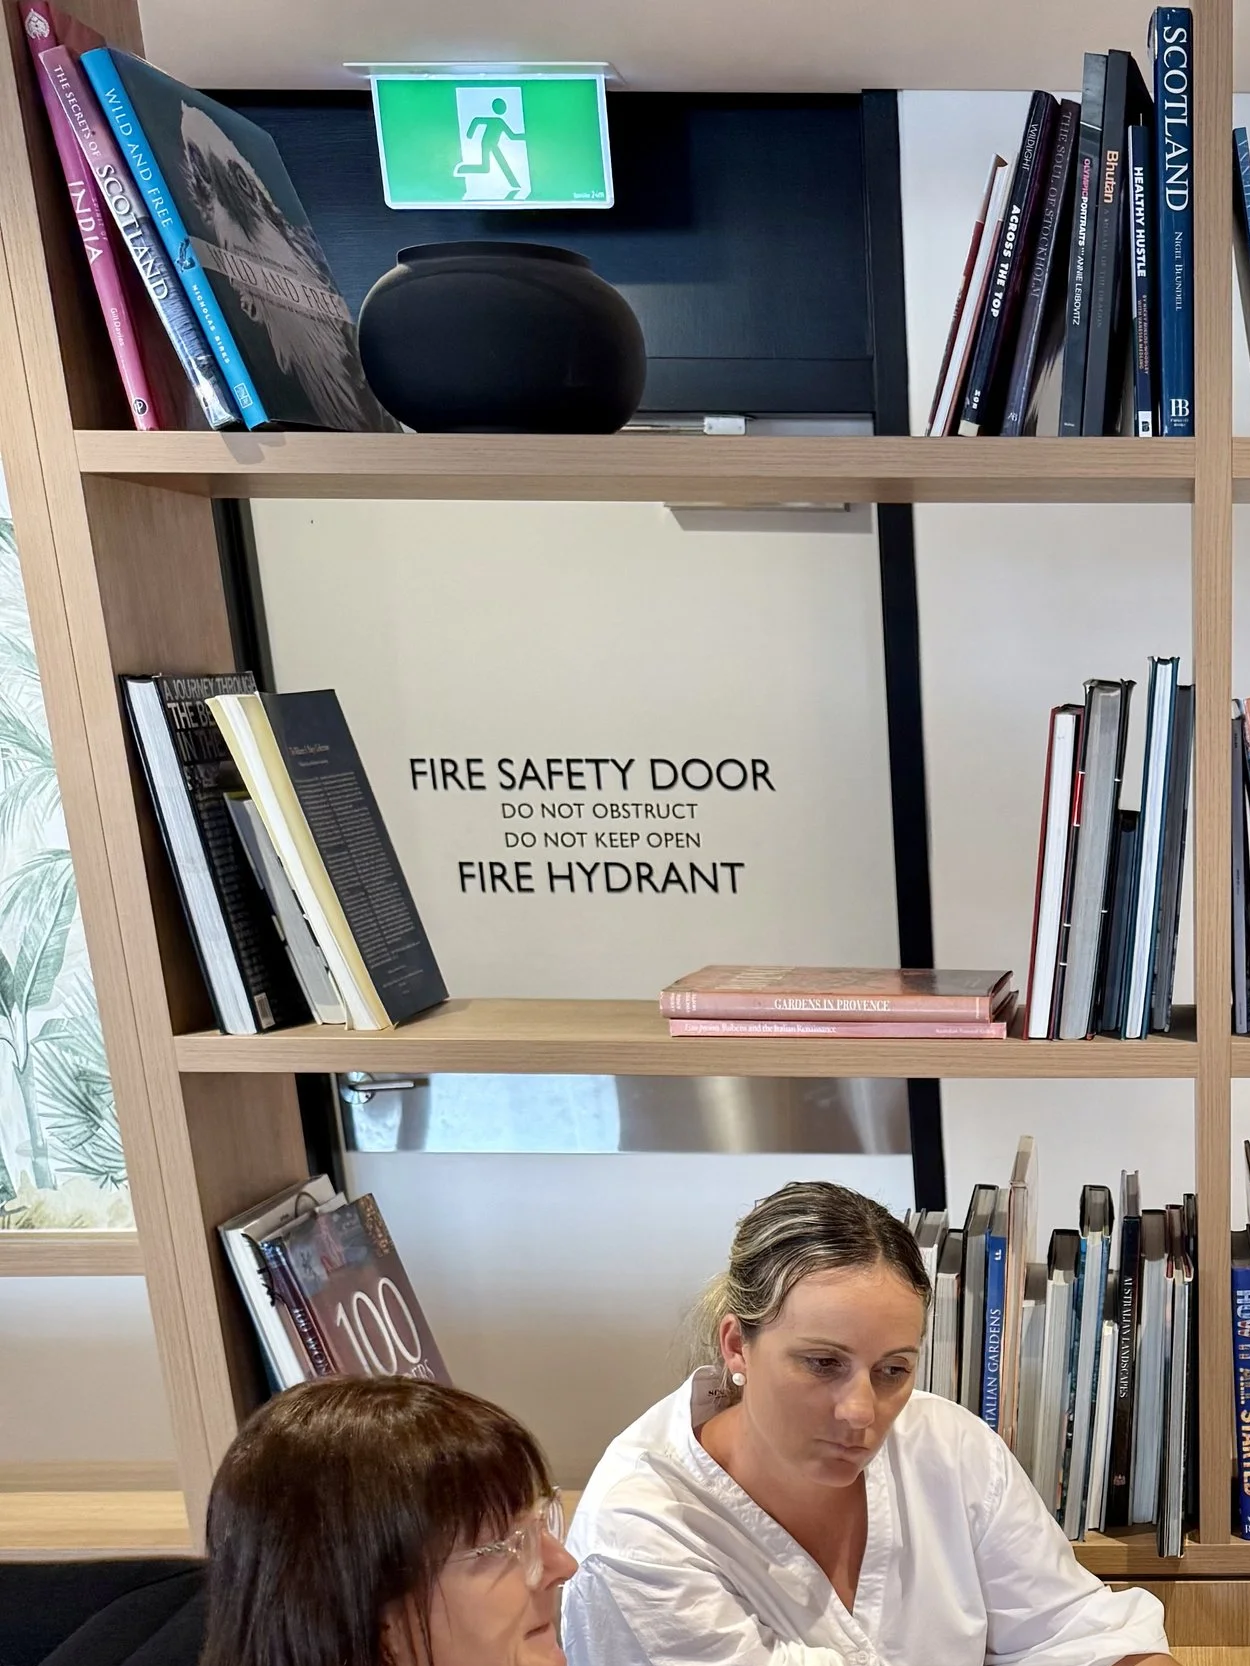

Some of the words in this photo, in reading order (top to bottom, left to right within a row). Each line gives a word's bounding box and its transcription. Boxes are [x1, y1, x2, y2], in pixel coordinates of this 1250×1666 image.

[54, 65, 70, 89] THE
[65, 92, 93, 139] SECRETS
[88, 139, 102, 158] OF
[1056, 111, 1071, 142] THE
[1162, 26, 1189, 210] SCOTLAND
[104, 88, 133, 137] WILD
[128, 143, 153, 182] AND
[149, 188, 172, 227] FREE
[1023, 123, 1039, 171] WILDLIGHT
[1049, 144, 1065, 184] SOUL
[1045, 188, 1058, 207] OF
[1103, 150, 1118, 203] Bhutan
[1133, 167, 1145, 226] HEALTHY
[69, 181, 103, 266] INDIA
[96, 164, 171, 301] SCOTLAND
[1000, 204, 1021, 257] ACROSS
[995, 261, 1008, 286] THE
[1031, 208, 1054, 297] STOCKHOLM
[1075, 256, 1084, 281] ANNIE
[1134, 229, 1146, 276] HUSTLE
[206, 244, 257, 286] WILD
[261, 268, 300, 303] AND
[301, 284, 344, 319] FREE
[988, 290, 1002, 317] TOP
[1071, 283, 1082, 325] LEIBOVITZ
[1174, 264, 1183, 311] BLUNDELL
[109, 306, 120, 321] Gill
[112, 321, 126, 346] Davies
[192, 285, 216, 332] NICHOLAS
[214, 336, 231, 364] BIRKS
[163, 680, 172, 700] A
[173, 679, 214, 698] JOURNEY
[167, 702, 198, 729] THE
[410, 758, 486, 791] FIRE
[498, 758, 635, 791] SAFETY
[650, 758, 776, 791] DOOR
[502, 803, 533, 819] DO
[541, 803, 585, 819] NOT
[592, 803, 698, 819] OBSTRUCT
[505, 832, 536, 848] DO
[544, 832, 588, 848] NOT
[595, 832, 640, 848] KEEP
[647, 832, 701, 848] OPEN
[459, 862, 534, 893] FIRE
[547, 862, 745, 894] HYDRANT
[748, 1024, 762, 1032] and
[774, 999, 822, 1010] GARDENS
[824, 999, 835, 1009] IN
[836, 999, 890, 1012] PROVENCE
[336, 1277, 421, 1377] 100
[1121, 1276, 1132, 1334] AUSTRALIAN
[986, 1308, 1000, 1372] GARDENS
[1118, 1337, 1129, 1397] LANDSCAPES
[984, 1376, 997, 1428] ITALIAN
